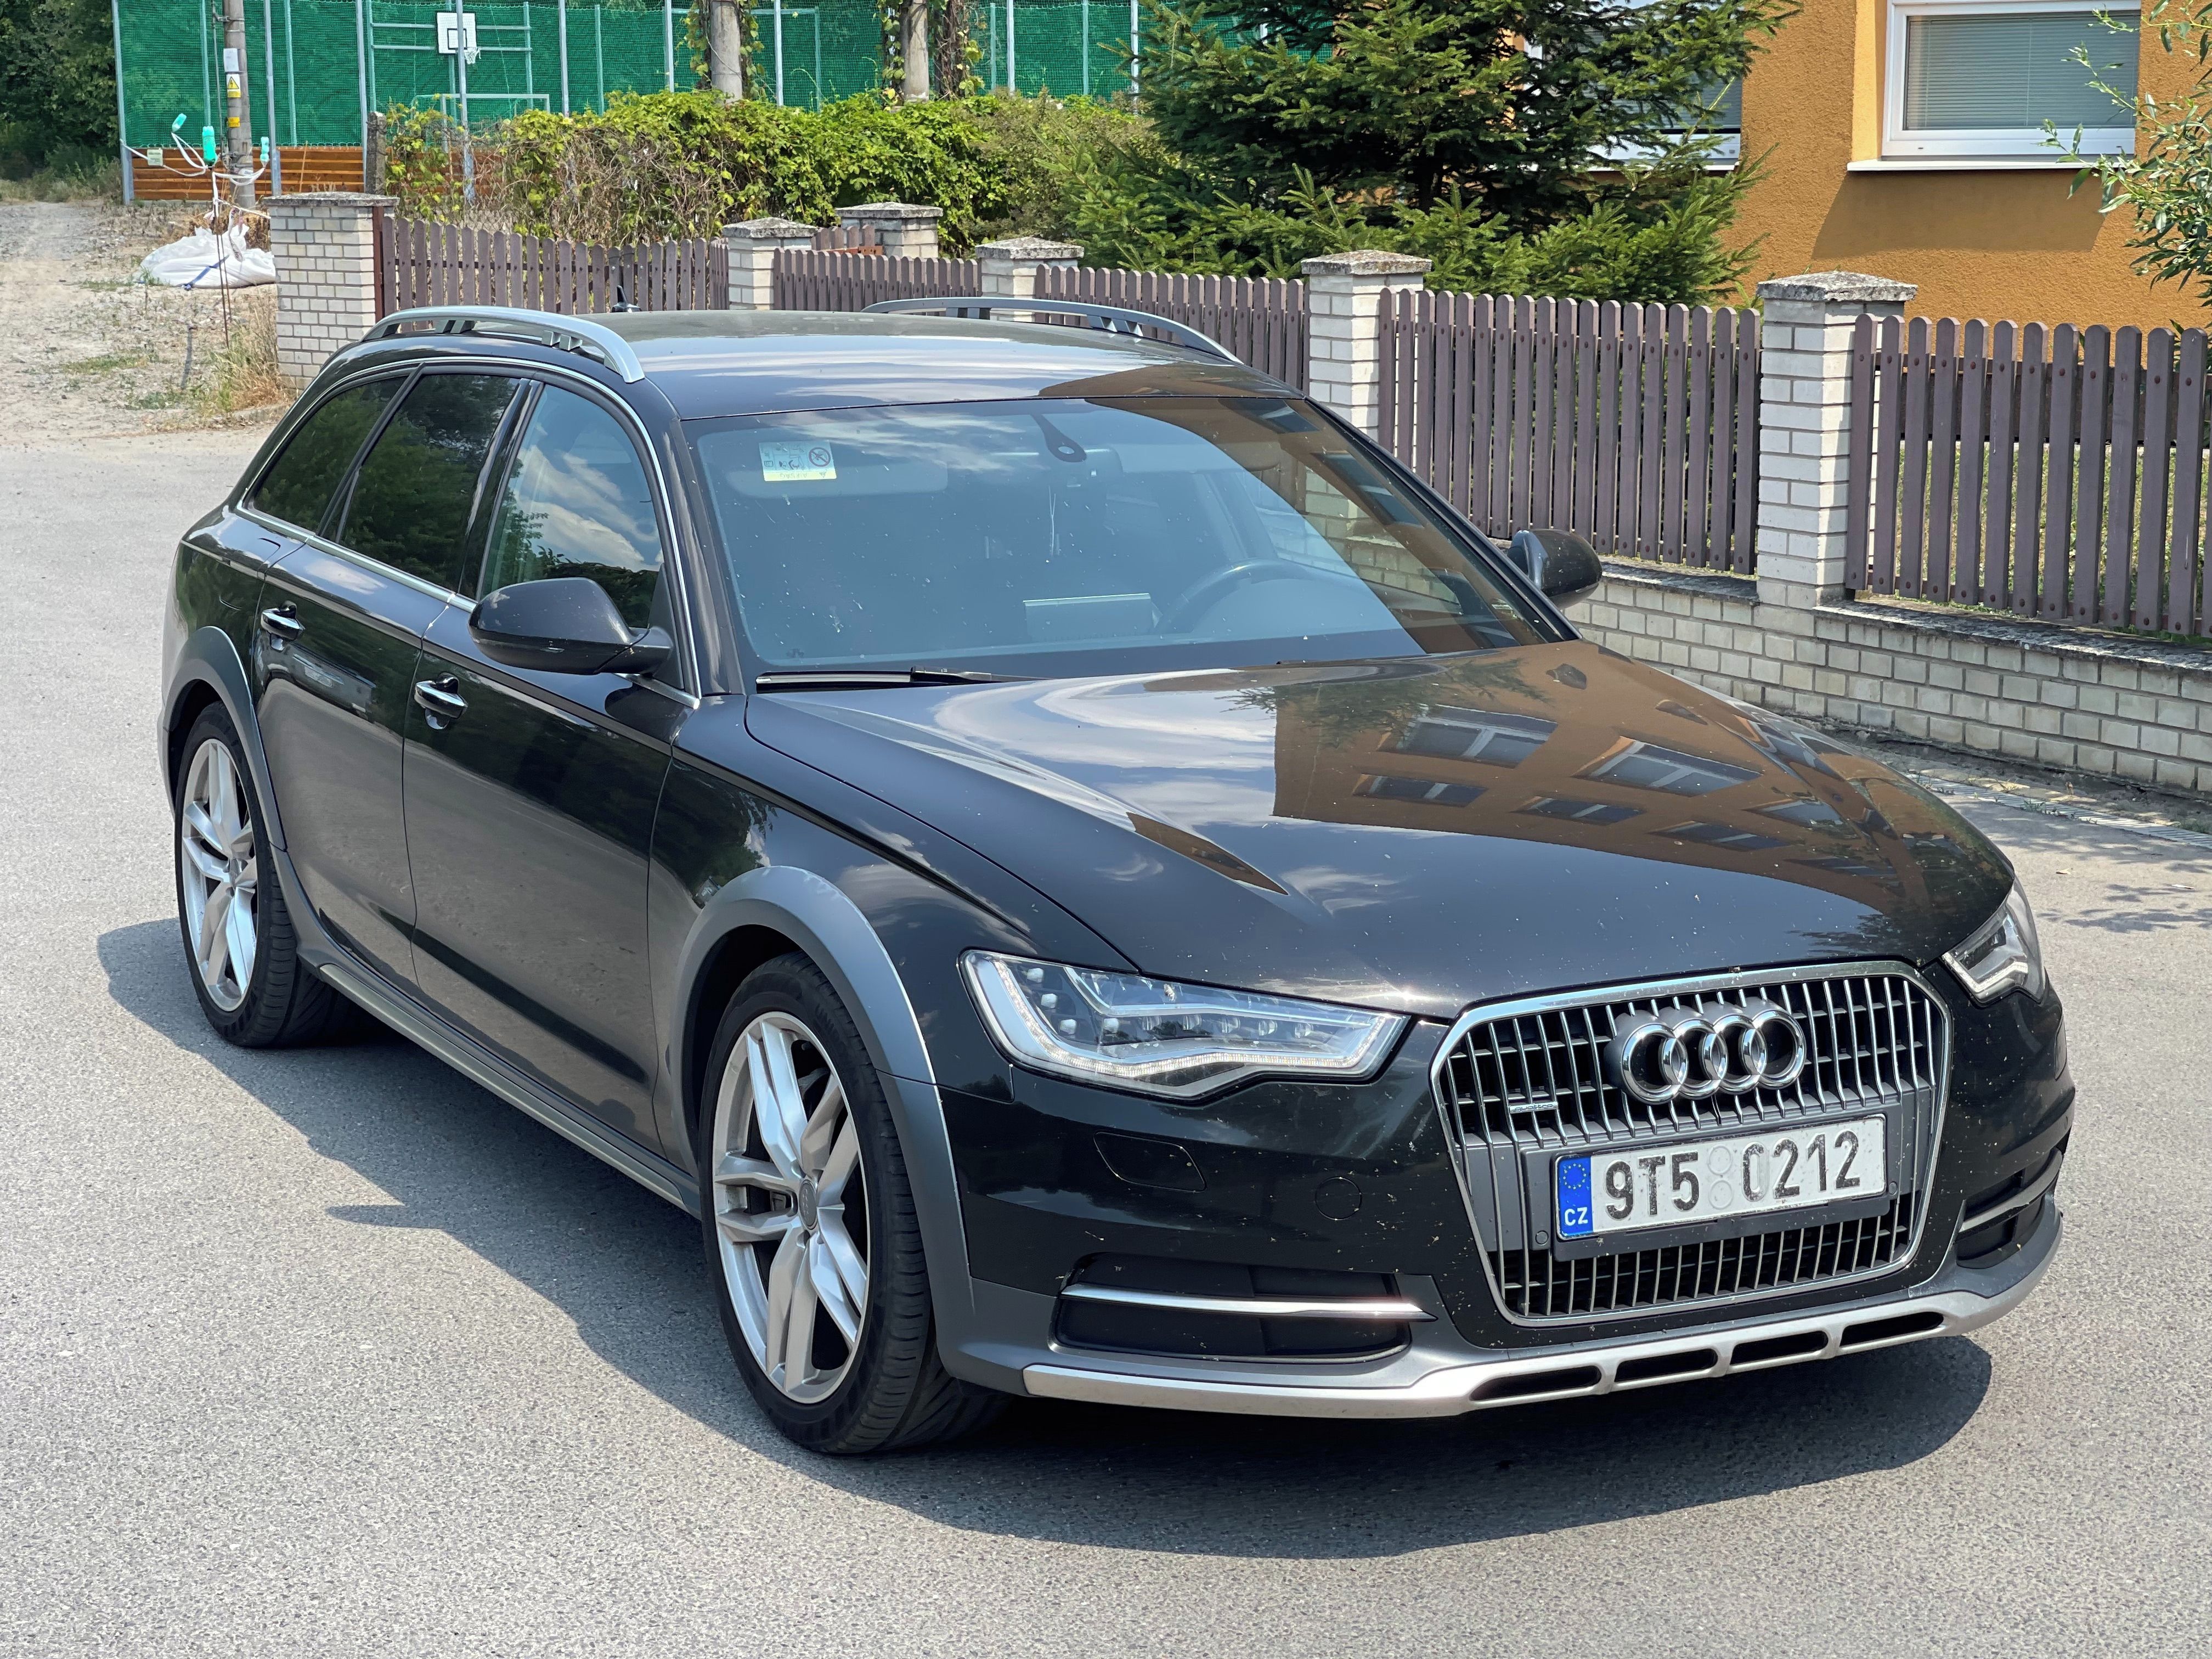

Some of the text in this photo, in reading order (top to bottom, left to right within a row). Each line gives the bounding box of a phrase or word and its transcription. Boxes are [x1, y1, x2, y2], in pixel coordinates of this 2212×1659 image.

[1515, 1104, 1553, 1112] quattro
[1605, 1130, 1861, 1221] 9T5 0212
[1564, 1207, 1588, 1226] CZ
